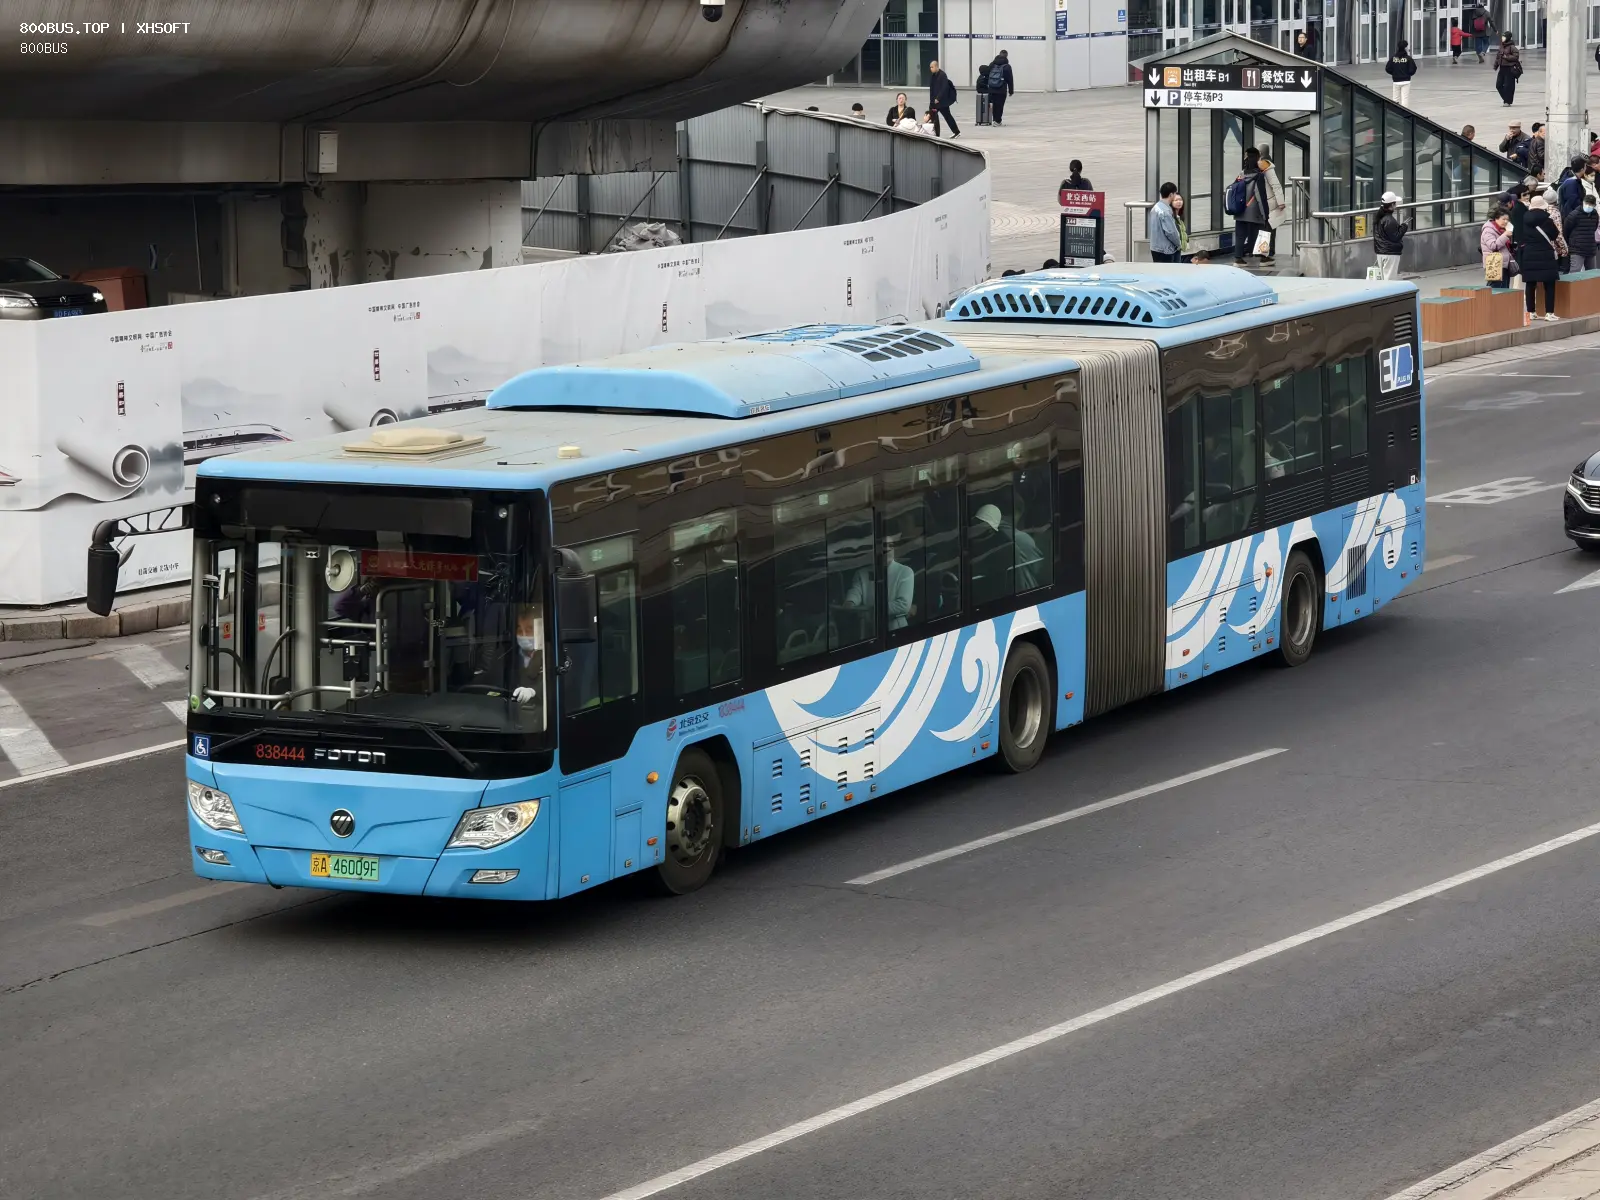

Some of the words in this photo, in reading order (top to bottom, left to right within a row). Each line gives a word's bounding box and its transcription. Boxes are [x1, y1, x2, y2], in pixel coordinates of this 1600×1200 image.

[1261, 70, 1296, 84] 餐饮区
[1184, 91, 1223, 103] 停车场P3
[1066, 192, 1096, 203] 北京西站
[678, 711, 709, 730] 北京公交
[255, 743, 306, 761] 838444
[314, 748, 386, 765] FOTON
